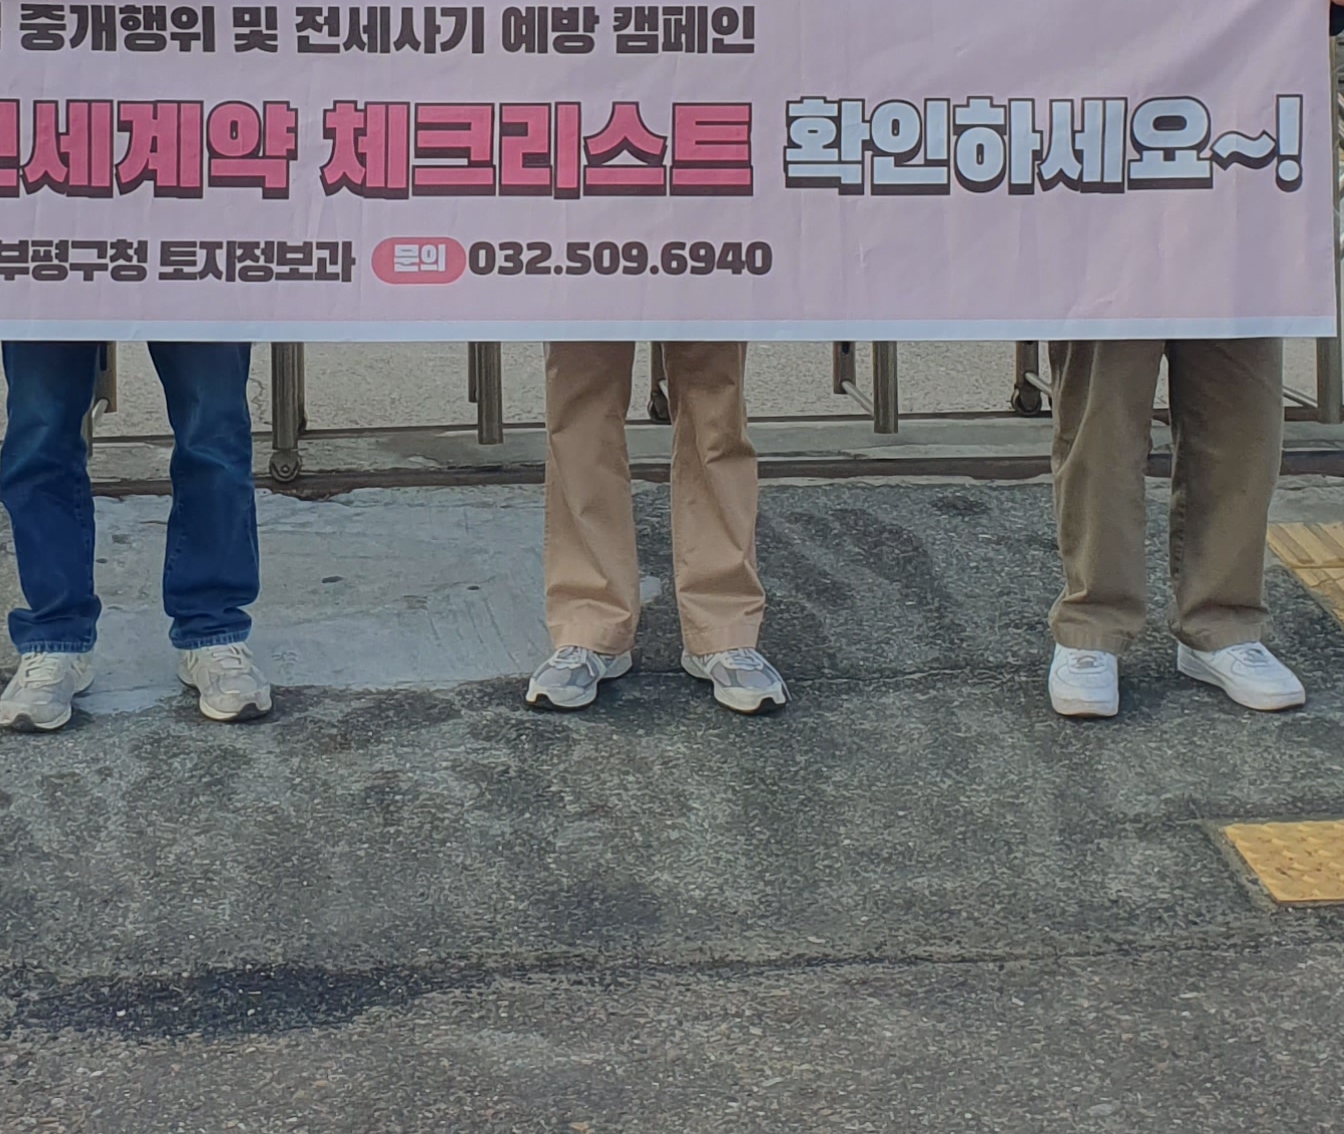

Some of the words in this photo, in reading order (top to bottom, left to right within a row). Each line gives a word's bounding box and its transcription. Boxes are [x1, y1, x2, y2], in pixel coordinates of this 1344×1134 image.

[19, 3, 216, 53] 중개행위
[233, 5, 279, 53] 및
[295, 6, 485, 54] 전세사기
[501, 6, 600, 55] 예방
[613, 5, 755, 54] 캠페인
[320, 100, 754, 201] 체크리스트
[783, 94, 1304, 196] 확인하세요~!
[158, 240, 356, 283] 토지정보과
[393, 243, 446, 274] 문의
[468, 241, 773, 276] 032.509.6940
